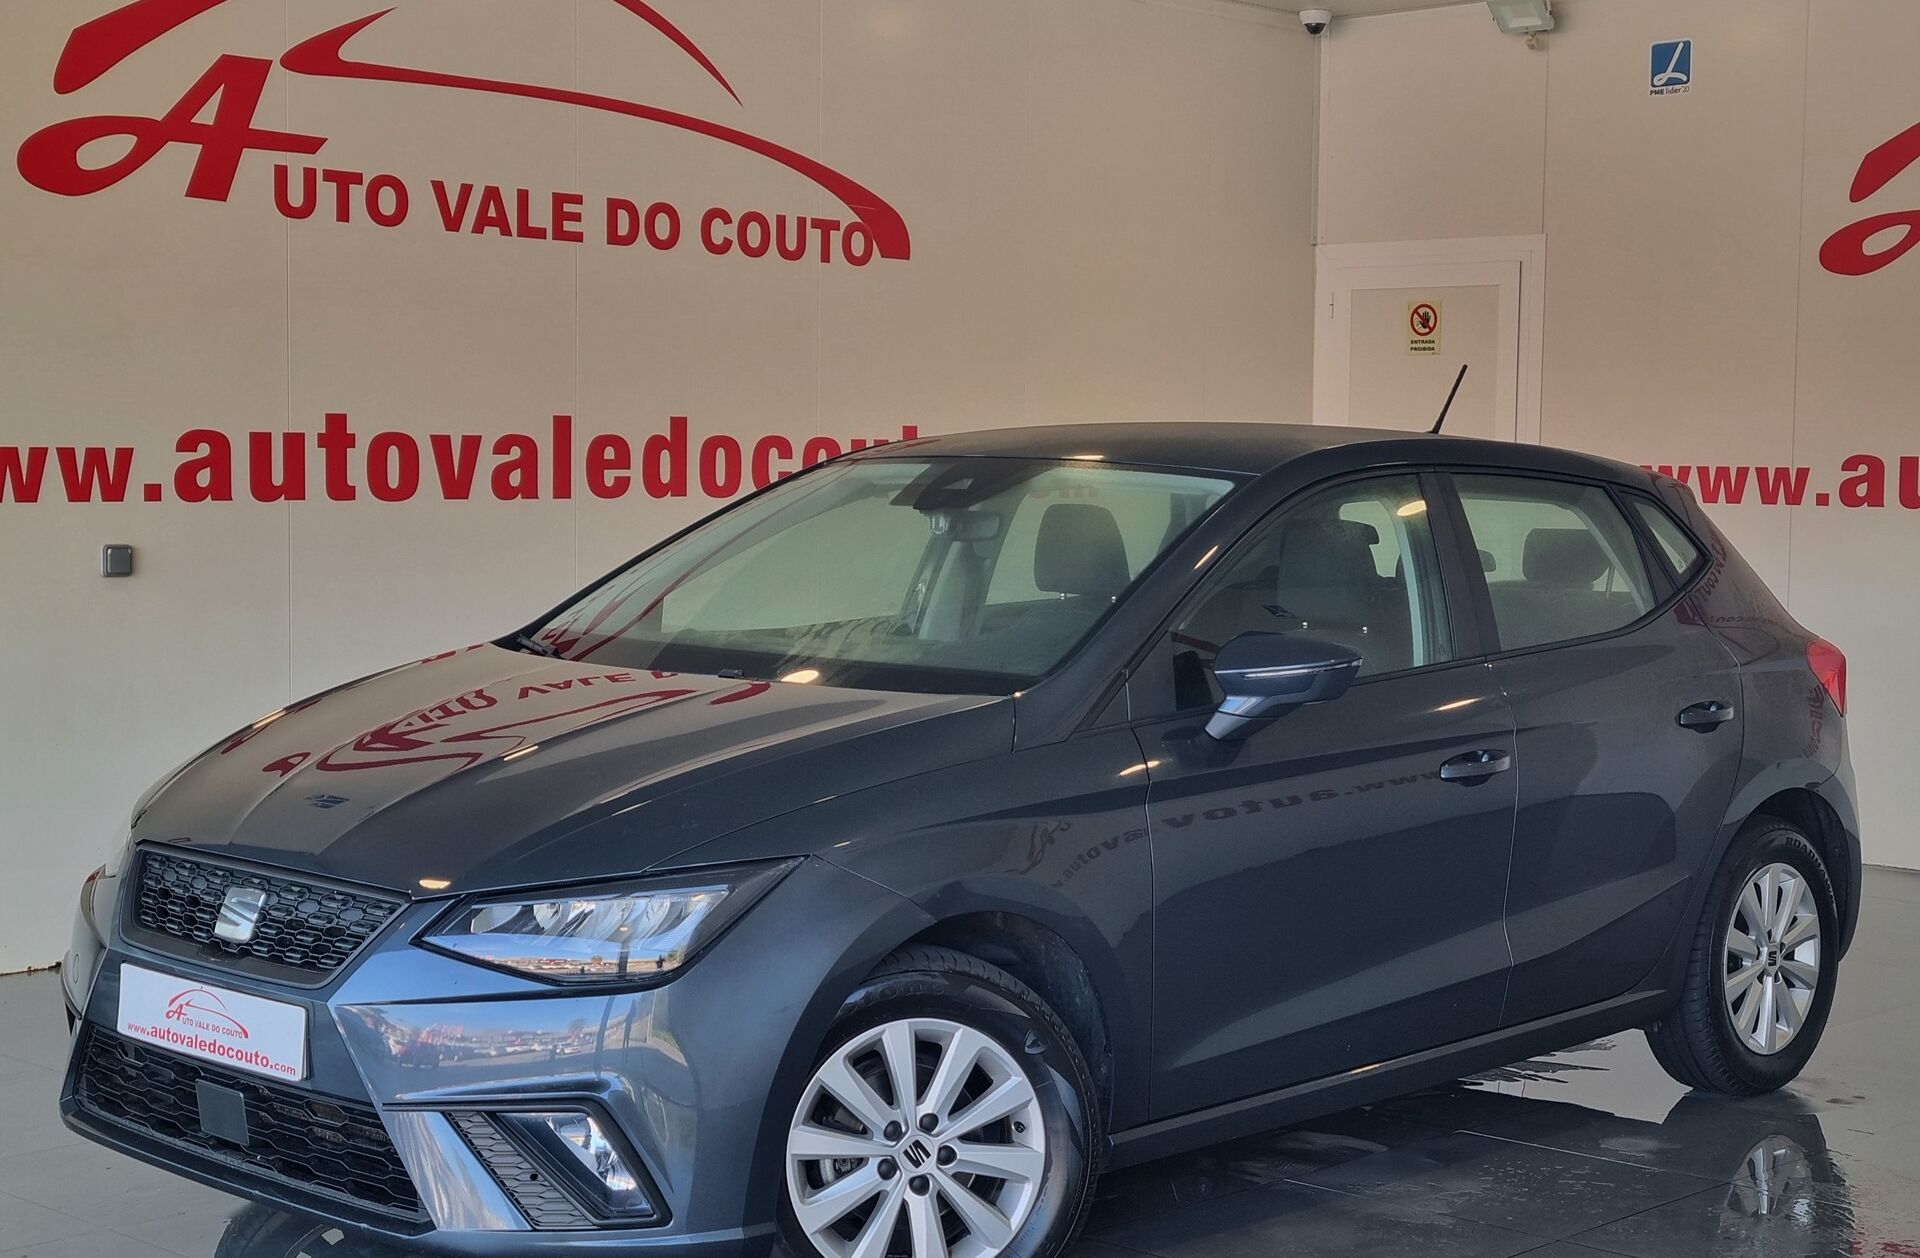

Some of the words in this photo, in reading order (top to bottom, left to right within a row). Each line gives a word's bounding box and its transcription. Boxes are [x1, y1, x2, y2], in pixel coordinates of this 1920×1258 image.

[430, 180, 585, 243] VALE
[606, 197, 681, 251] DO
[701, 207, 874, 268] COUTO
[127, 1022, 296, 1076] www.autovaledocouto.com
[194, 1018, 210, 1031] VALE
[211, 1023, 221, 1033] DO
[221, 1027, 243, 1039] COUTO
